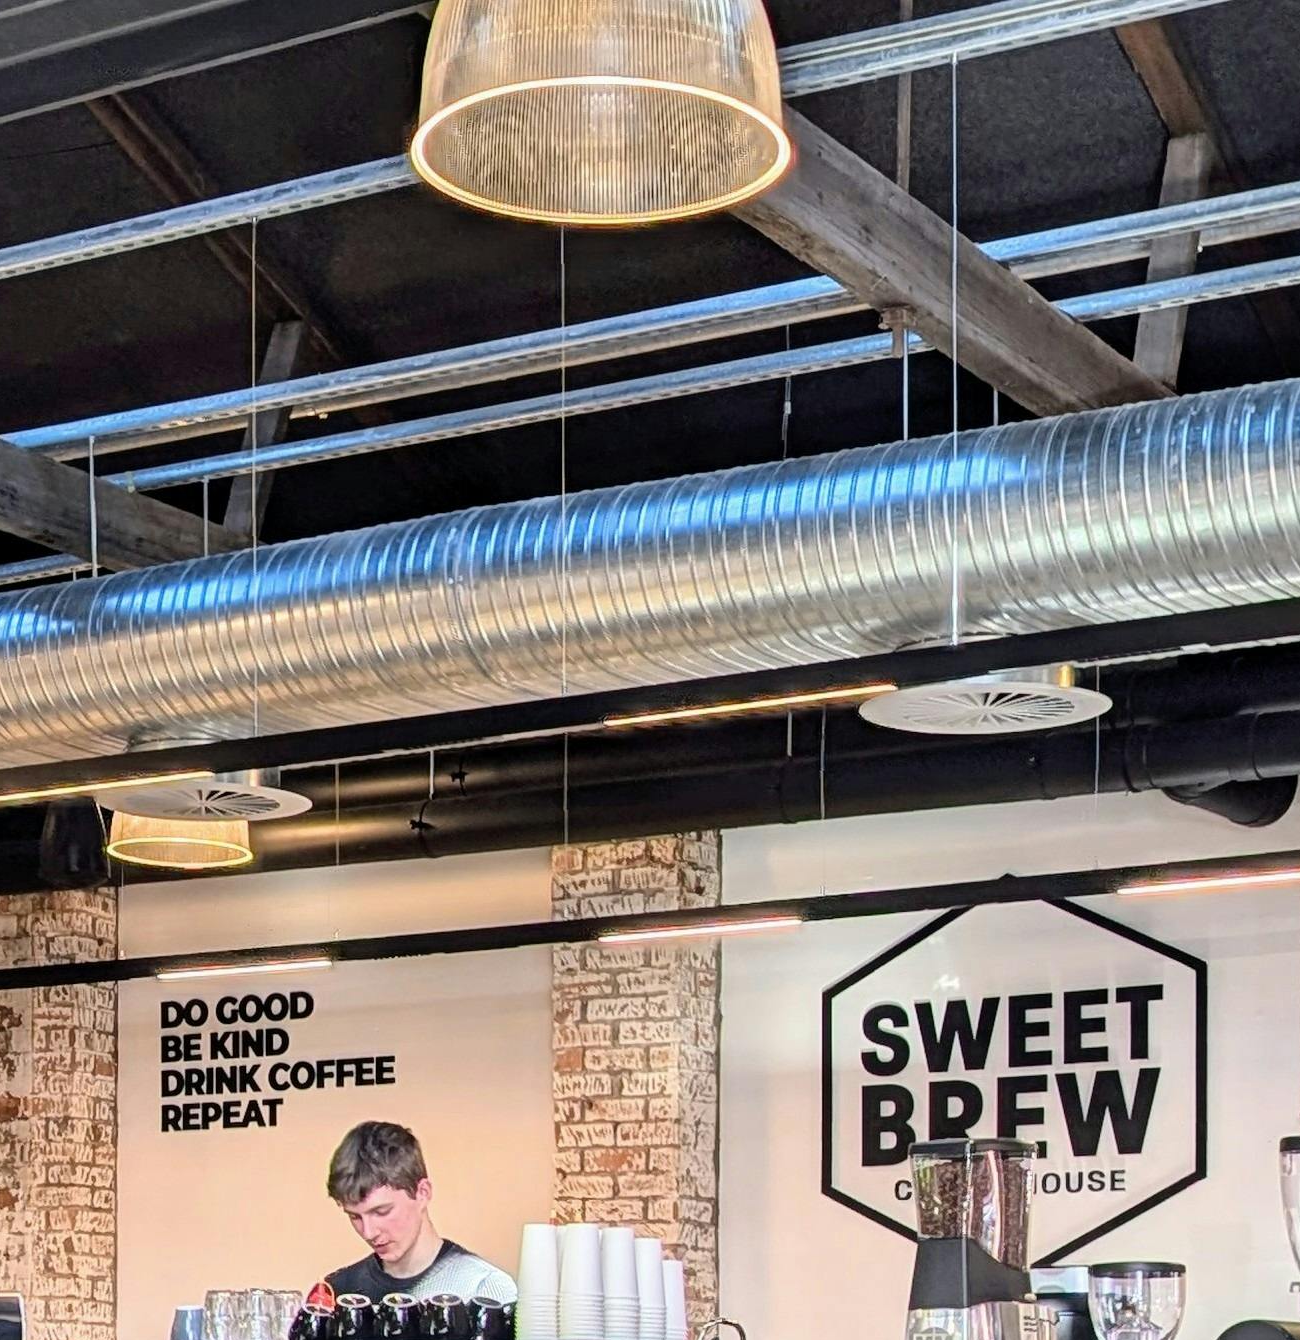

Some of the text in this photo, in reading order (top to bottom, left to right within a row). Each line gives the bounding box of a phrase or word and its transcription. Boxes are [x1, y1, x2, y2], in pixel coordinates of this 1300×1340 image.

[160, 990, 315, 1030] DO GOOD
[861, 983, 1164, 1077] SWEET
[160, 1027, 290, 1064] BE KIND
[160, 1055, 396, 1098] DRINK COFFEE
[160, 1097, 284, 1133] REPEAT
[861, 1067, 1161, 1167] BREW
[1033, 1169, 1127, 1195] OUSE
